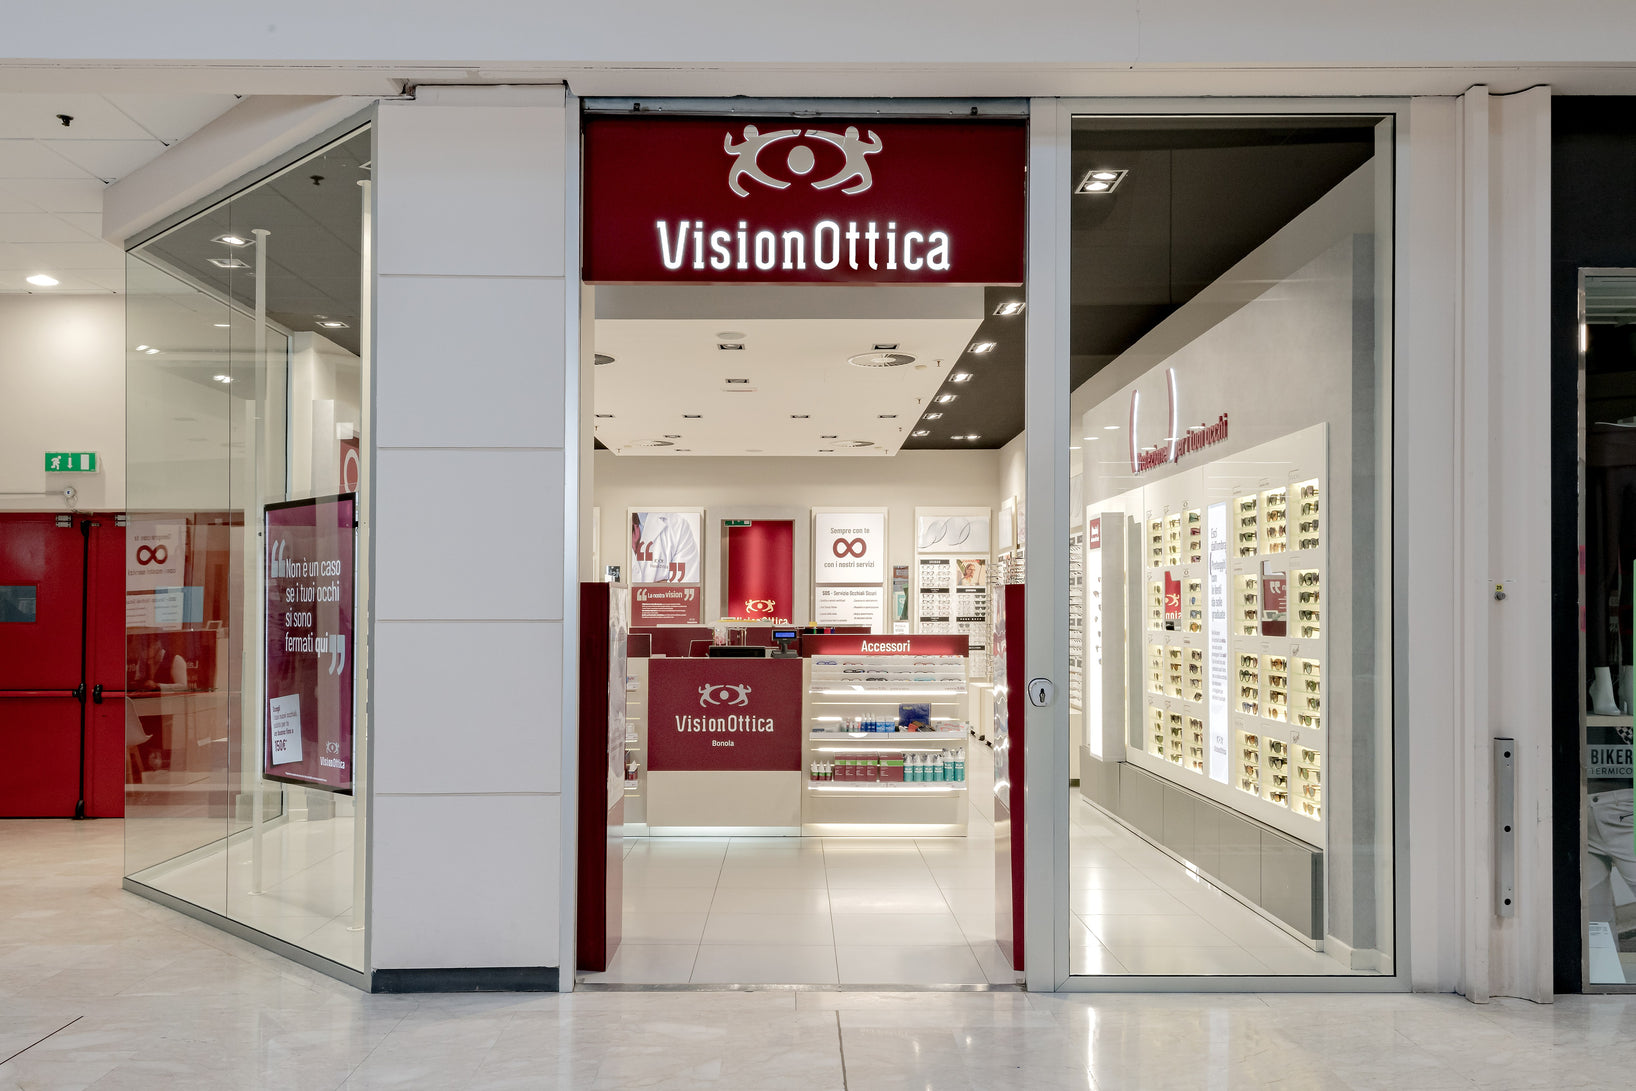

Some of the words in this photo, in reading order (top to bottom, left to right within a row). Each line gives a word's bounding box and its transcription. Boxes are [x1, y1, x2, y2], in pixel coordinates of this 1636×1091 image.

[656, 220, 951, 272] VisionOttica
[1191, 423, 1206, 451] tuoi
[1206, 412, 1228, 445] occhi
[830, 528, 851, 536] Sempre
[286, 558, 301, 578] Non
[303, 557, 308, 577] è
[310, 561, 319, 577] un
[321, 560, 341, 576] caso
[286, 587, 295, 602] se
[300, 581, 315, 602] tuoi
[317, 580, 340, 602] occhi
[665, 590, 682, 598] vision
[285, 607, 292, 627] si
[293, 612, 312, 627] sono
[285, 632, 314, 654] fermati
[315, 631, 329, 658] qui
[860, 640, 911, 653] Accessori
[675, 715, 774, 732] VisionOttica
[711, 739, 735, 747] Bonola
[1591, 748, 1633, 764] BIKER
